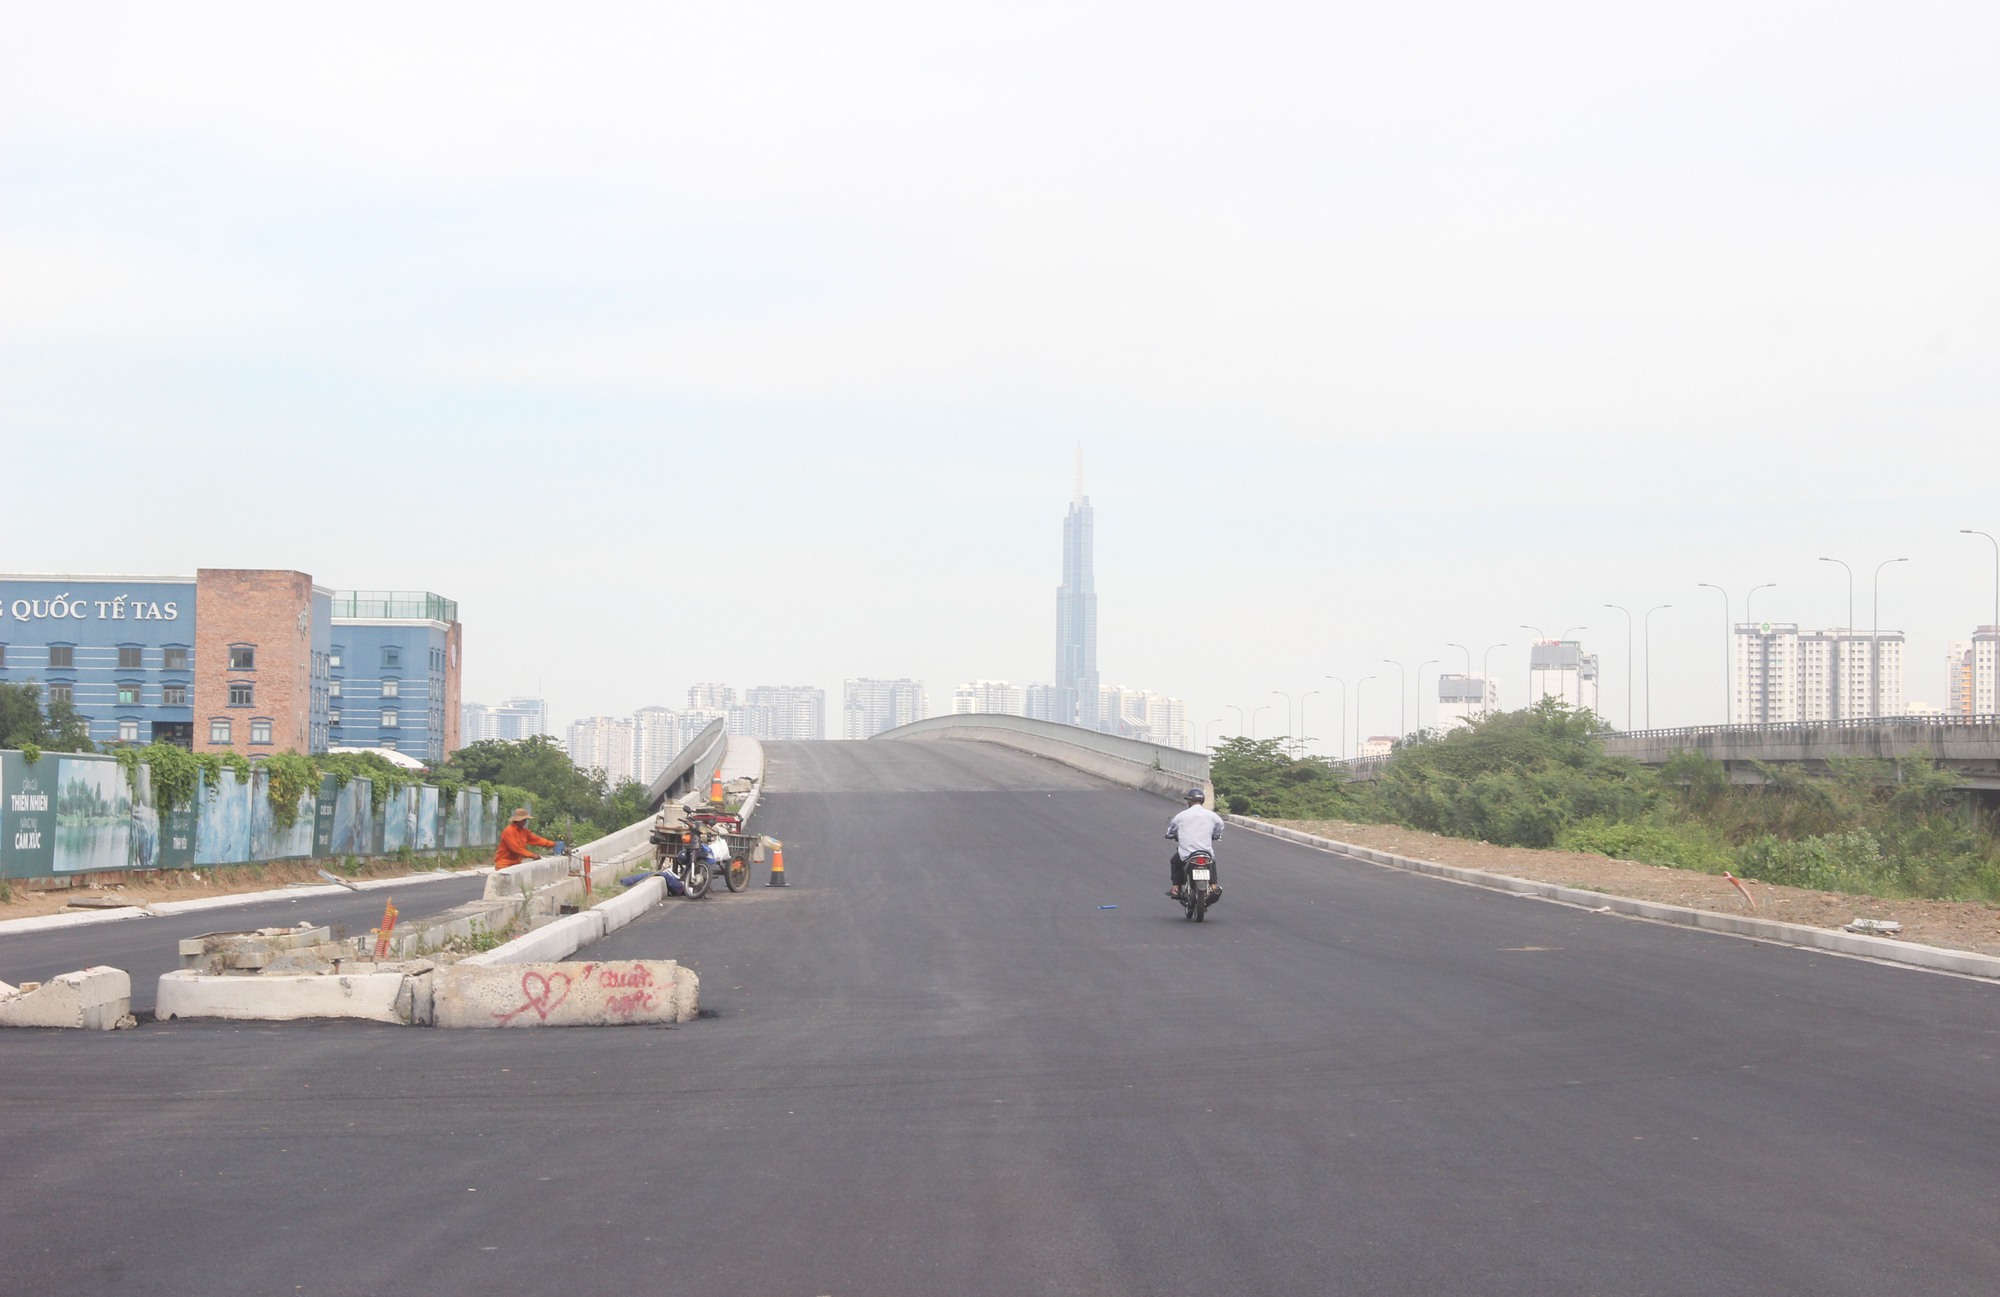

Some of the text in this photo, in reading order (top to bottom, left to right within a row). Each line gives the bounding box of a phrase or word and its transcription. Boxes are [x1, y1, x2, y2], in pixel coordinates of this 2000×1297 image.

[11, 592, 87, 622] QUỐC
[94, 594, 128, 620] TẾ
[131, 602, 178, 621] TAS
[11, 790, 48, 811] THIÊN NHIÊN
[15, 829, 41, 850] CẢM XÚC
